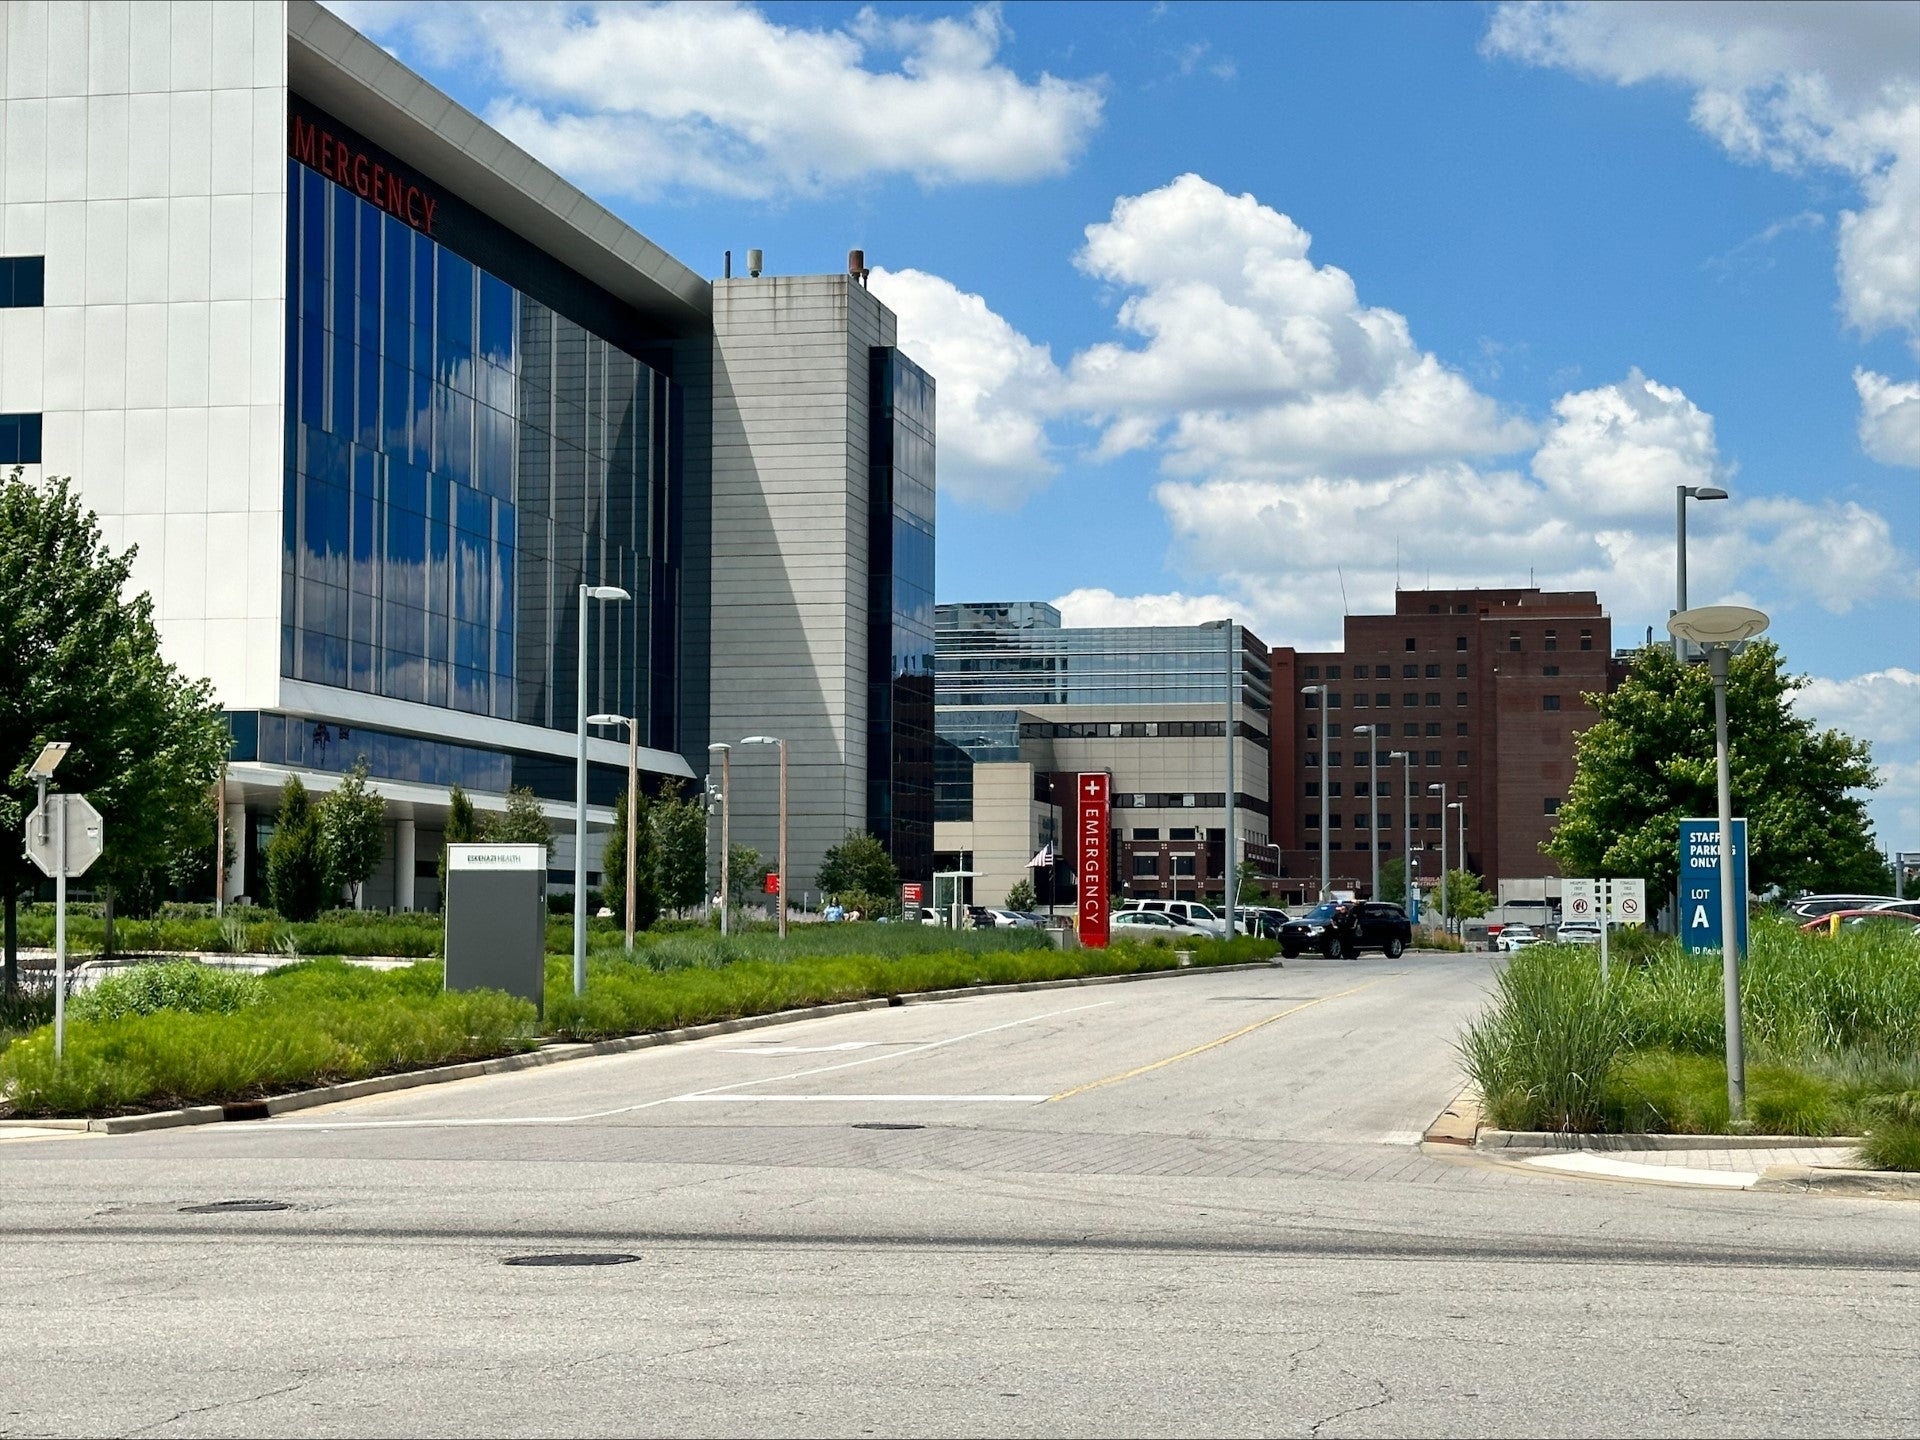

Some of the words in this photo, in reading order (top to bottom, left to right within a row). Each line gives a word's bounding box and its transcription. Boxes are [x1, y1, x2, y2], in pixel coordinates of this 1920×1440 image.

[294, 115, 437, 233] MERGENCY
[1690, 832, 1720, 843] STAFF
[1690, 845, 1736, 855] PARKIG
[1085, 809, 1099, 924] EMERGENCY
[1690, 857, 1717, 868] ONLY
[1691, 889, 1710, 900] LOT
[1691, 905, 1710, 928] A
